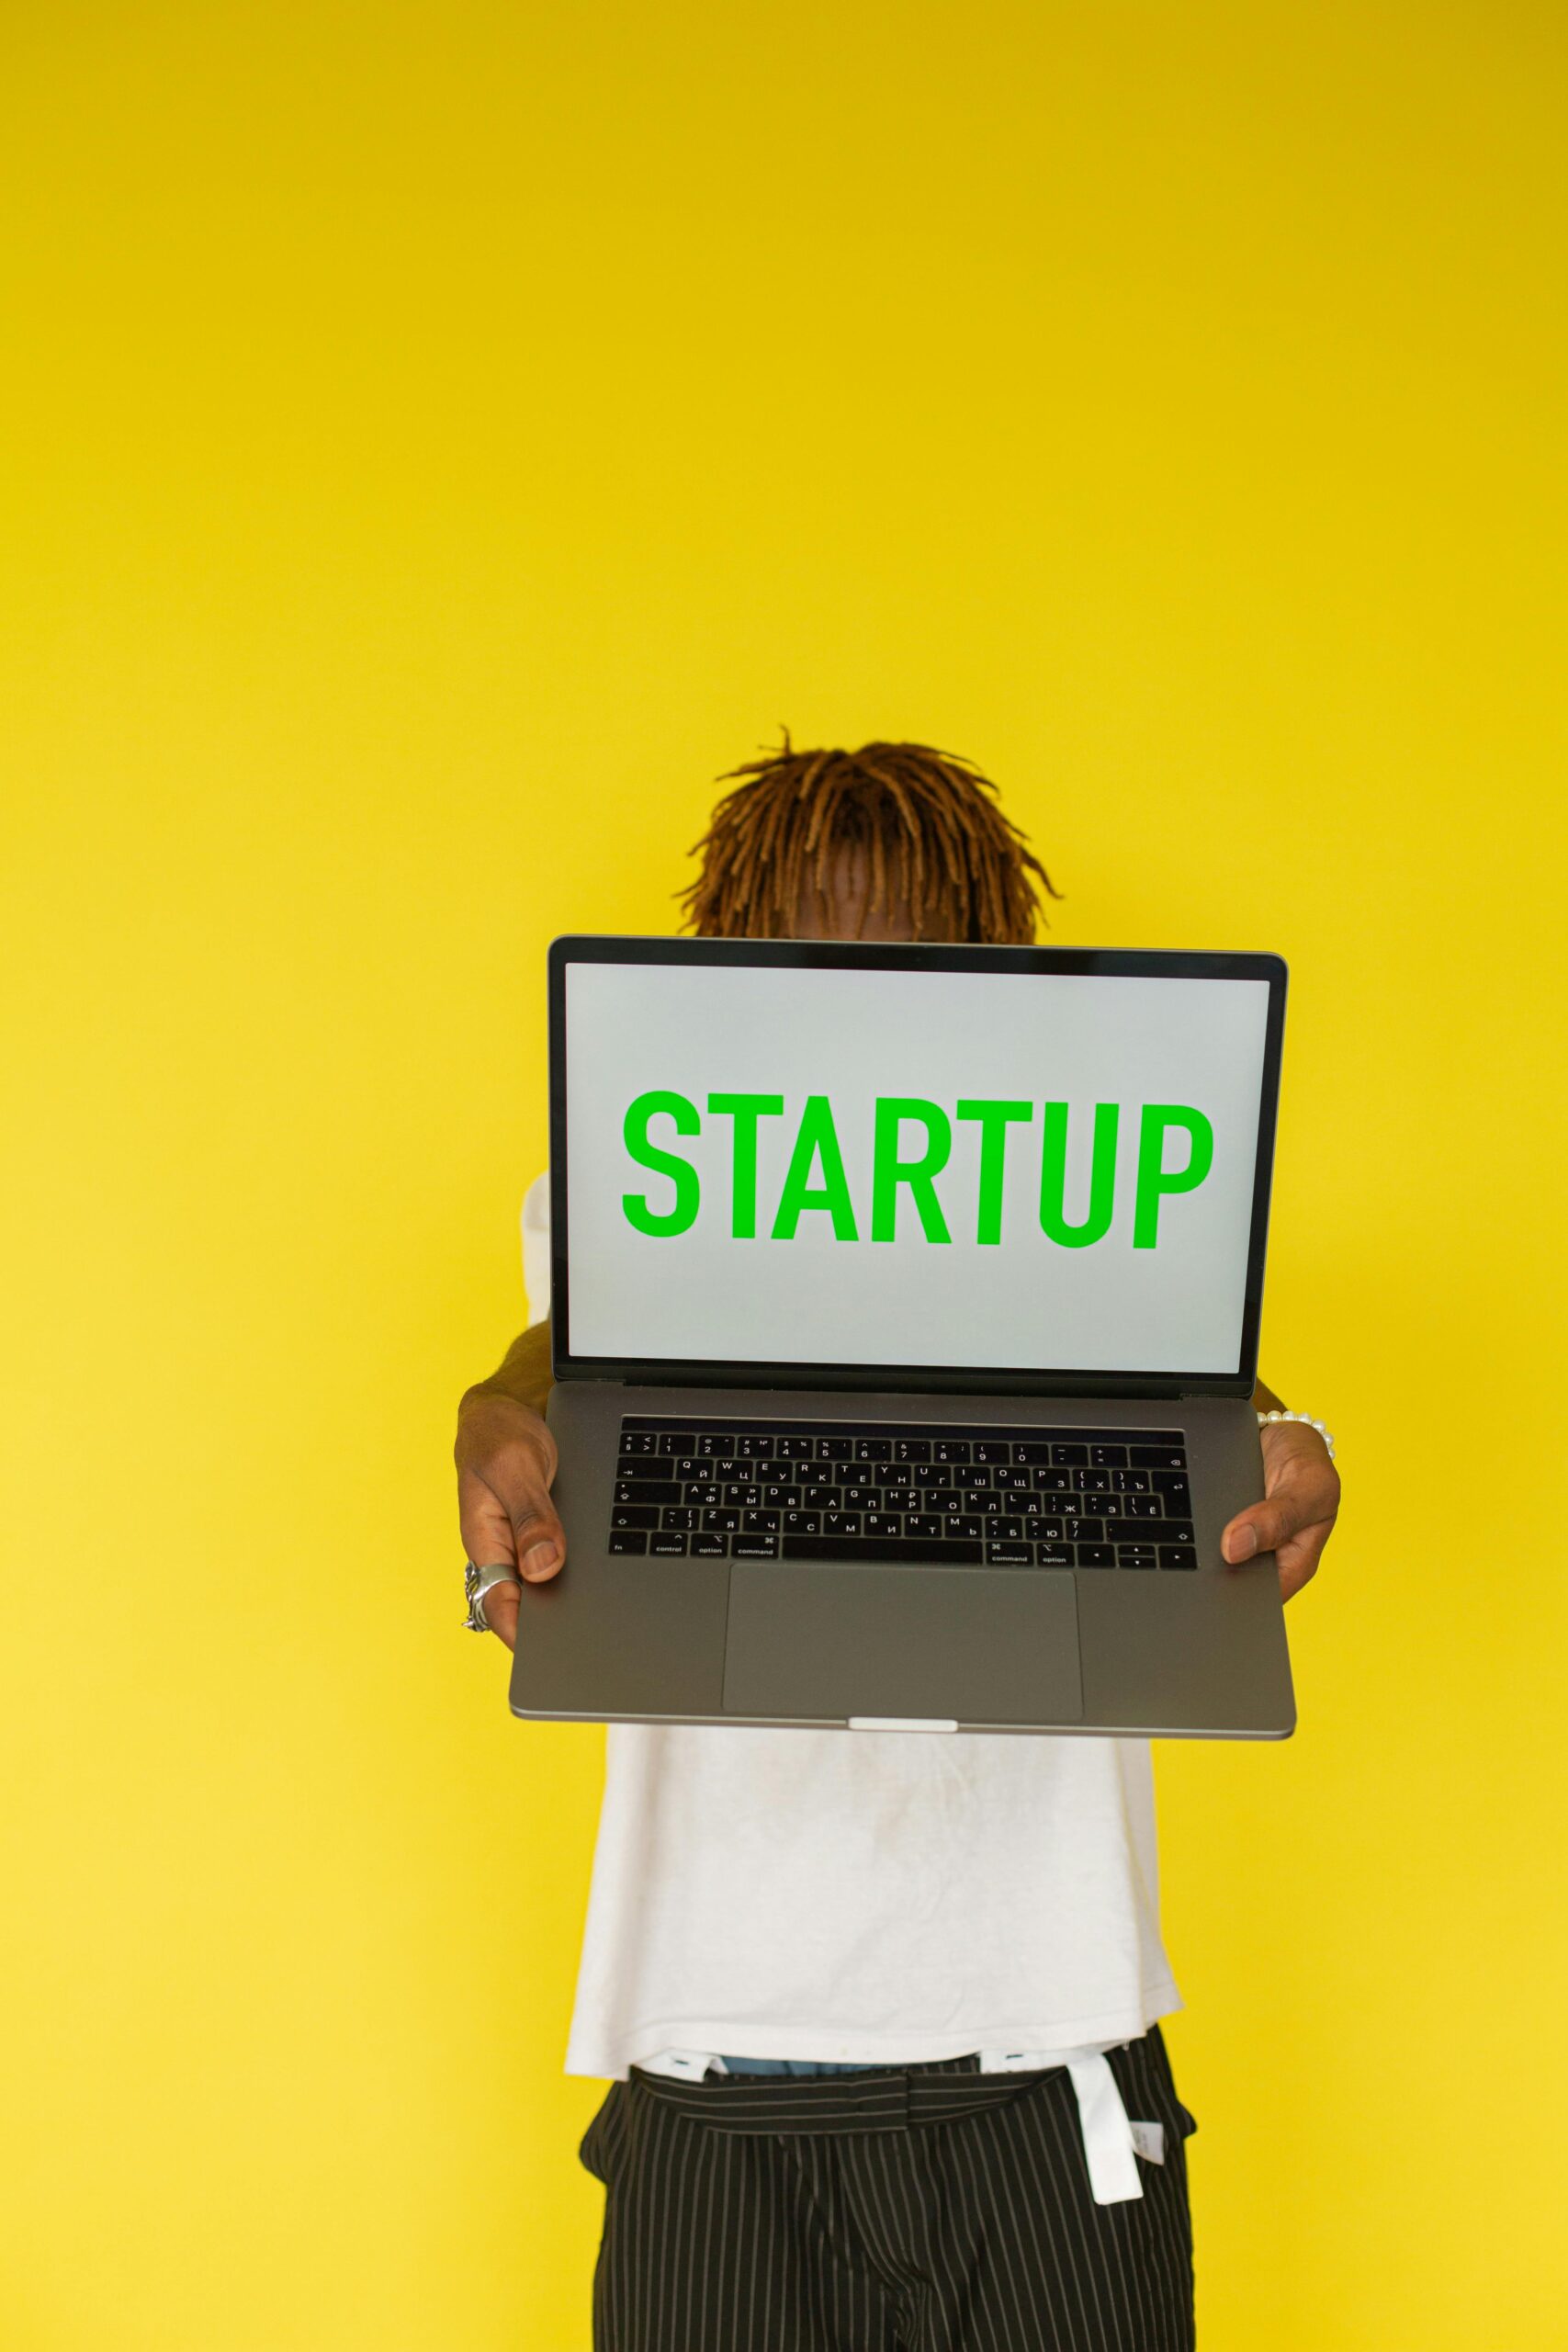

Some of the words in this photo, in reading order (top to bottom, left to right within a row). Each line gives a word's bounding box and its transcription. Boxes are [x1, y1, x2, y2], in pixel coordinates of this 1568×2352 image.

[622, 1091, 1213, 1250] STARTUP
[682, 1461, 691, 1469] Q
[761, 1463, 768, 1471] E
[739, 1472, 749, 1480] Ц
[1014, 1479, 1026, 1487] Щ
[1028, 1504, 1037, 1512] Д
[1149, 1506, 1156, 1514] Ё
[709, 1510, 716, 1519] Z
[789, 1513, 797, 1521] C
[1072, 1521, 1078, 1529] ?
[807, 1523, 815, 1532] С
